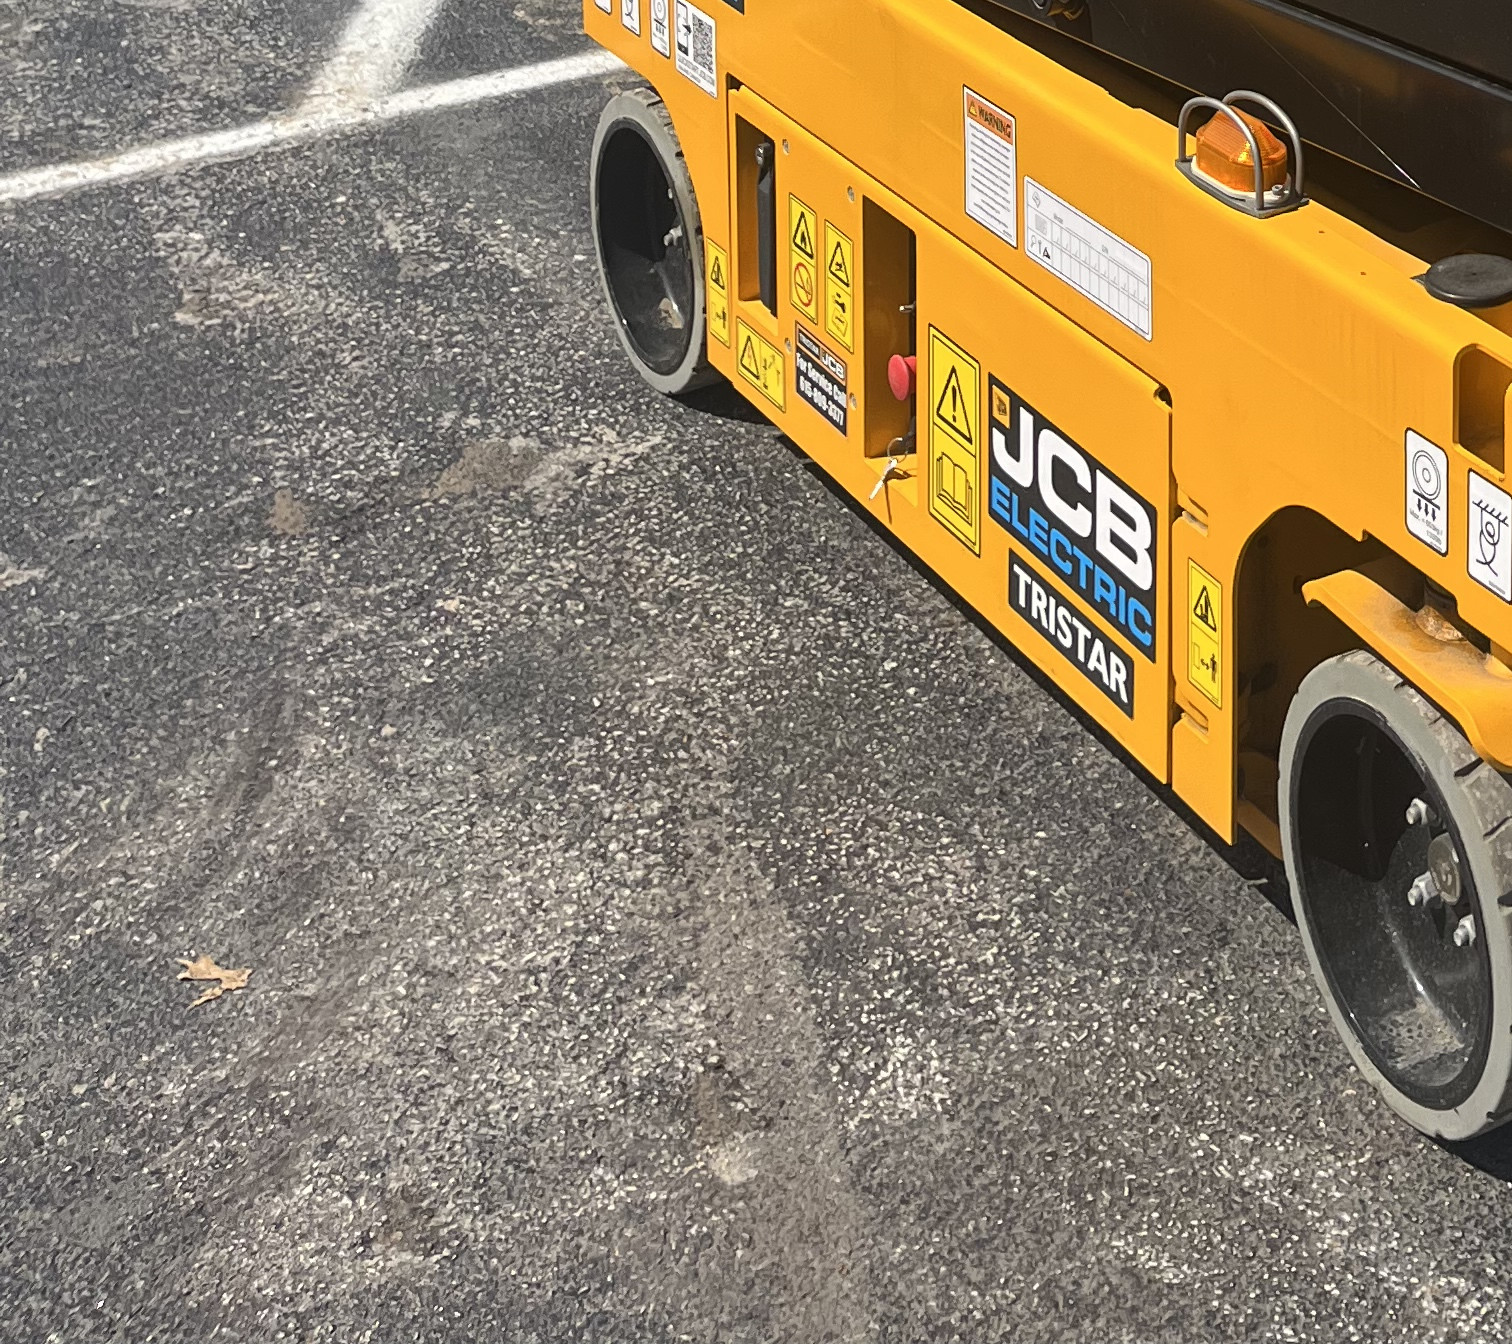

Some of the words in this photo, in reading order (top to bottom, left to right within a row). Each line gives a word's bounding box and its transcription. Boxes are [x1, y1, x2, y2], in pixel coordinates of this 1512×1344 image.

[978, 105, 1011, 139] WARNING
[822, 352, 845, 380] JCB
[991, 474, 1152, 647] ELECTRIC
[992, 406, 1153, 591] JCB
[1013, 563, 1128, 704] TRISTAR
